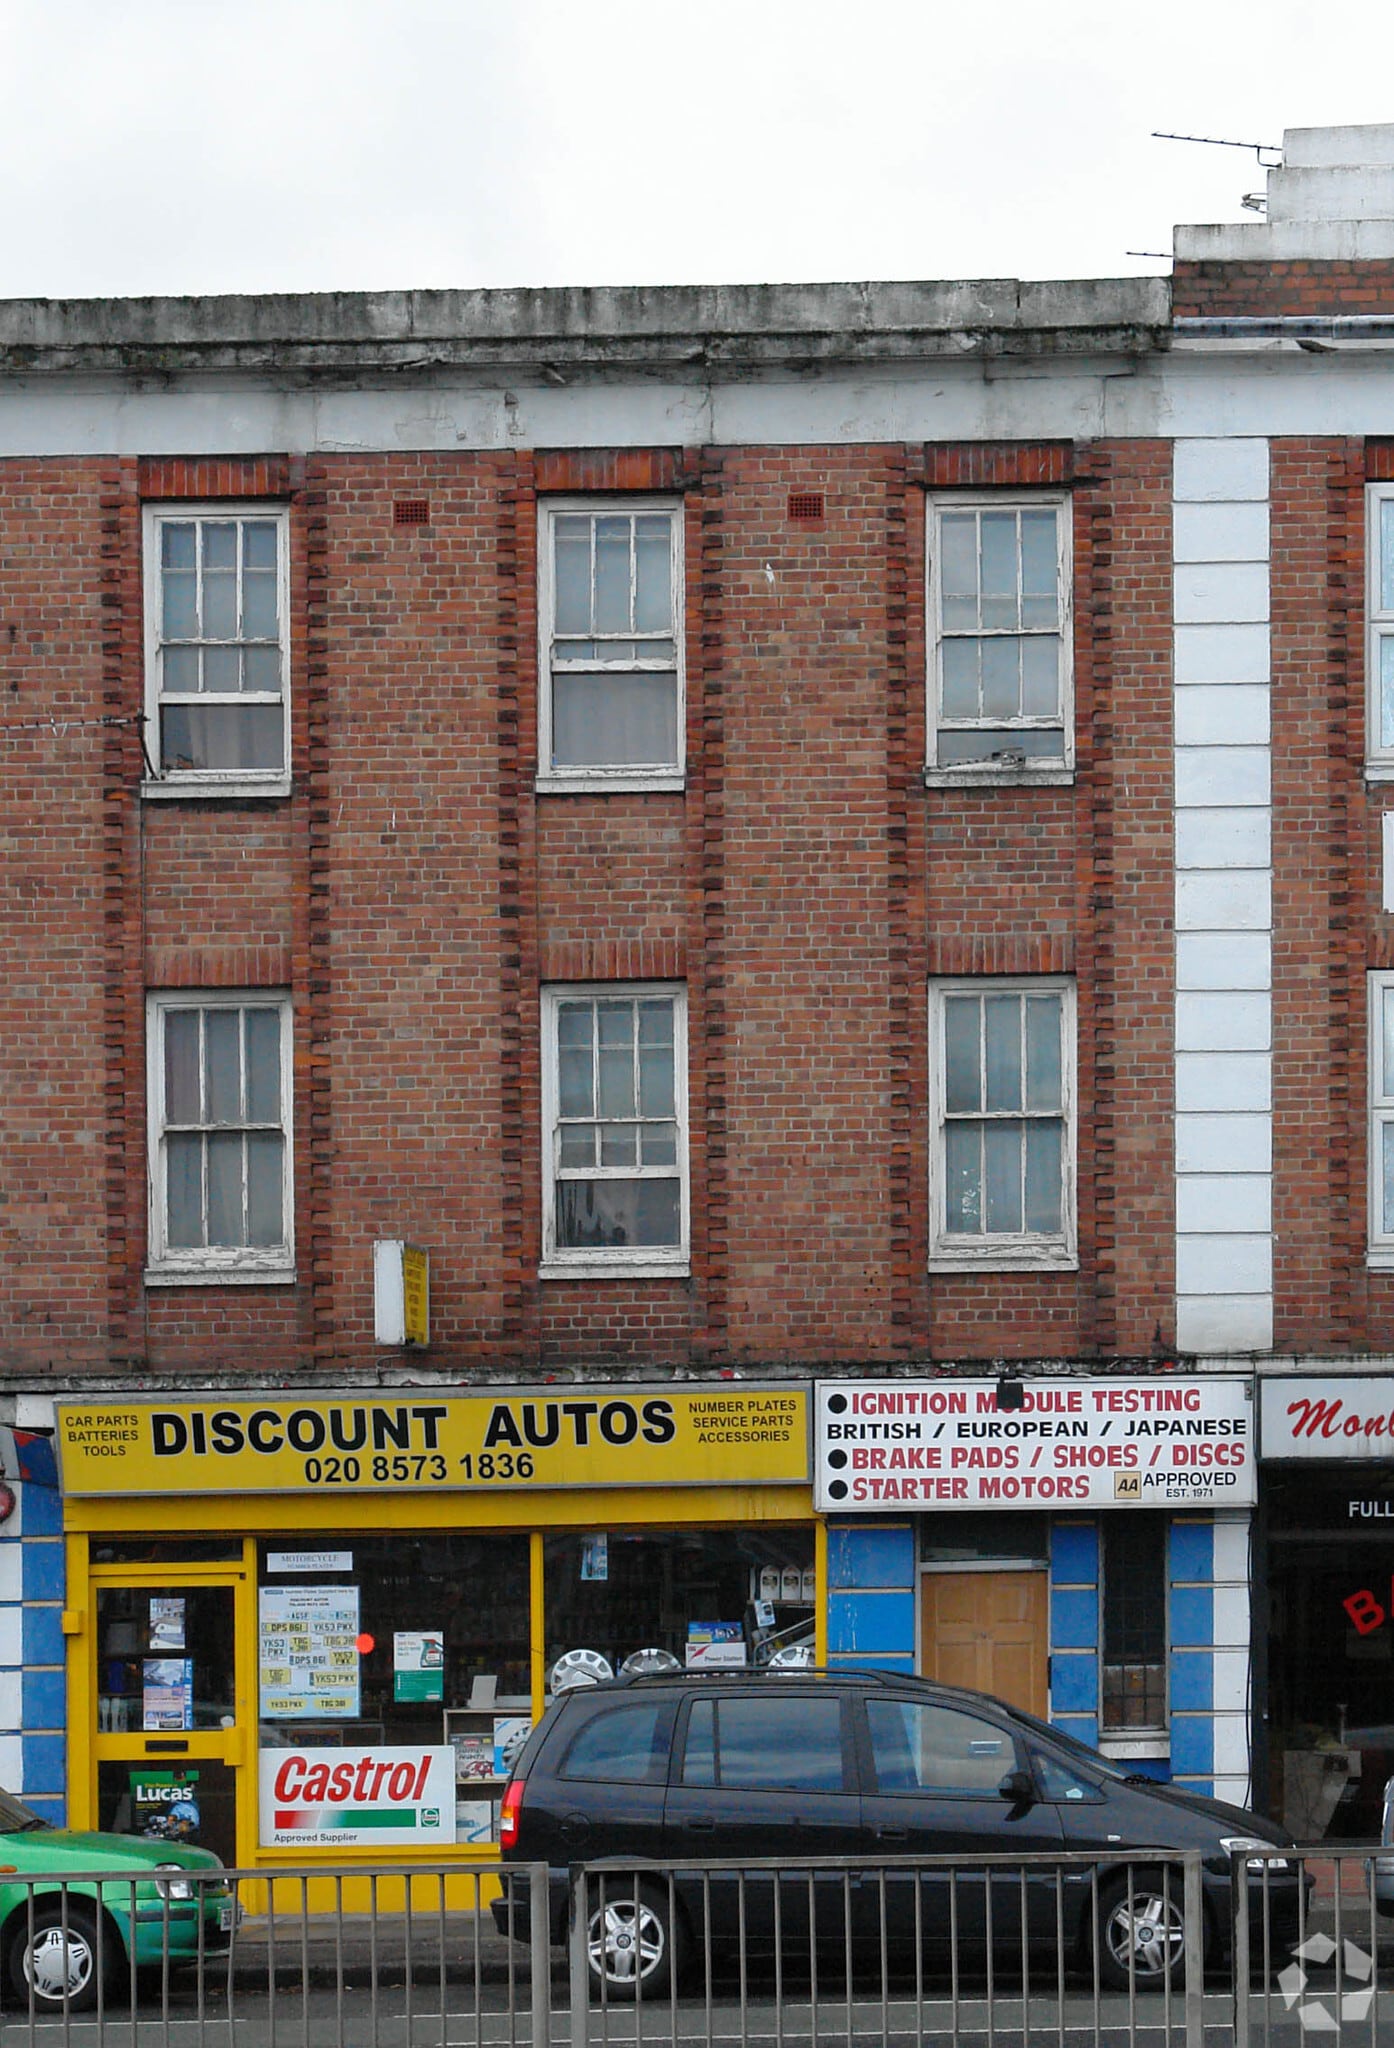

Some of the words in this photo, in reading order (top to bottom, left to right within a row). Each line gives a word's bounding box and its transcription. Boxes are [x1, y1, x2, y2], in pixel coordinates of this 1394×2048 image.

[688, 1401, 744, 1413] NUMBER
[748, 1400, 797, 1412] PLATES
[852, 1392, 967, 1415] IGNITION
[976, 1391, 1082, 1414] MDULE
[1092, 1389, 1200, 1413] TESTING
[65, 1415, 93, 1428] CAR
[96, 1414, 139, 1427] PARTS
[150, 1406, 448, 1456] DISCOUNT
[484, 1400, 676, 1449] AUTOS
[693, 1416, 749, 1429] SERVICE
[752, 1415, 794, 1427] PARTS
[68, 1430, 139, 1442] BATTERIES
[698, 1430, 790, 1443] ACCESSORIES
[827, 1422, 921, 1440] BRITISH
[957, 1421, 1089, 1438] EUROPEAN
[1123, 1419, 1247, 1437] JAPANESE
[83, 1445, 126, 1457] TOOLS
[852, 1447, 941, 1470] BRAKE
[951, 1445, 1019, 1469] PADS
[1053, 1444, 1138, 1468] SHOES
[1172, 1442, 1246, 1467] DISCS
[304, 1456, 361, 1483] 020
[372, 1455, 447, 1481] 8573
[459, 1453, 534, 1479] 1836
[1117, 1478, 1139, 1492] AA
[1143, 1472, 1237, 1487] APPROVED
[852, 1477, 970, 1501] STARTER
[978, 1475, 1090, 1500] MOTORS
[1166, 1488, 1190, 1498] EST.
[1192, 1487, 1213, 1498] 1971
[1349, 1501, 1394, 1517] FULL
[274, 1755, 432, 1802] Castrol
[136, 1785, 193, 1802] Lucas
[274, 1833, 318, 1843] Approved
[320, 1833, 358, 1843] Supplier
